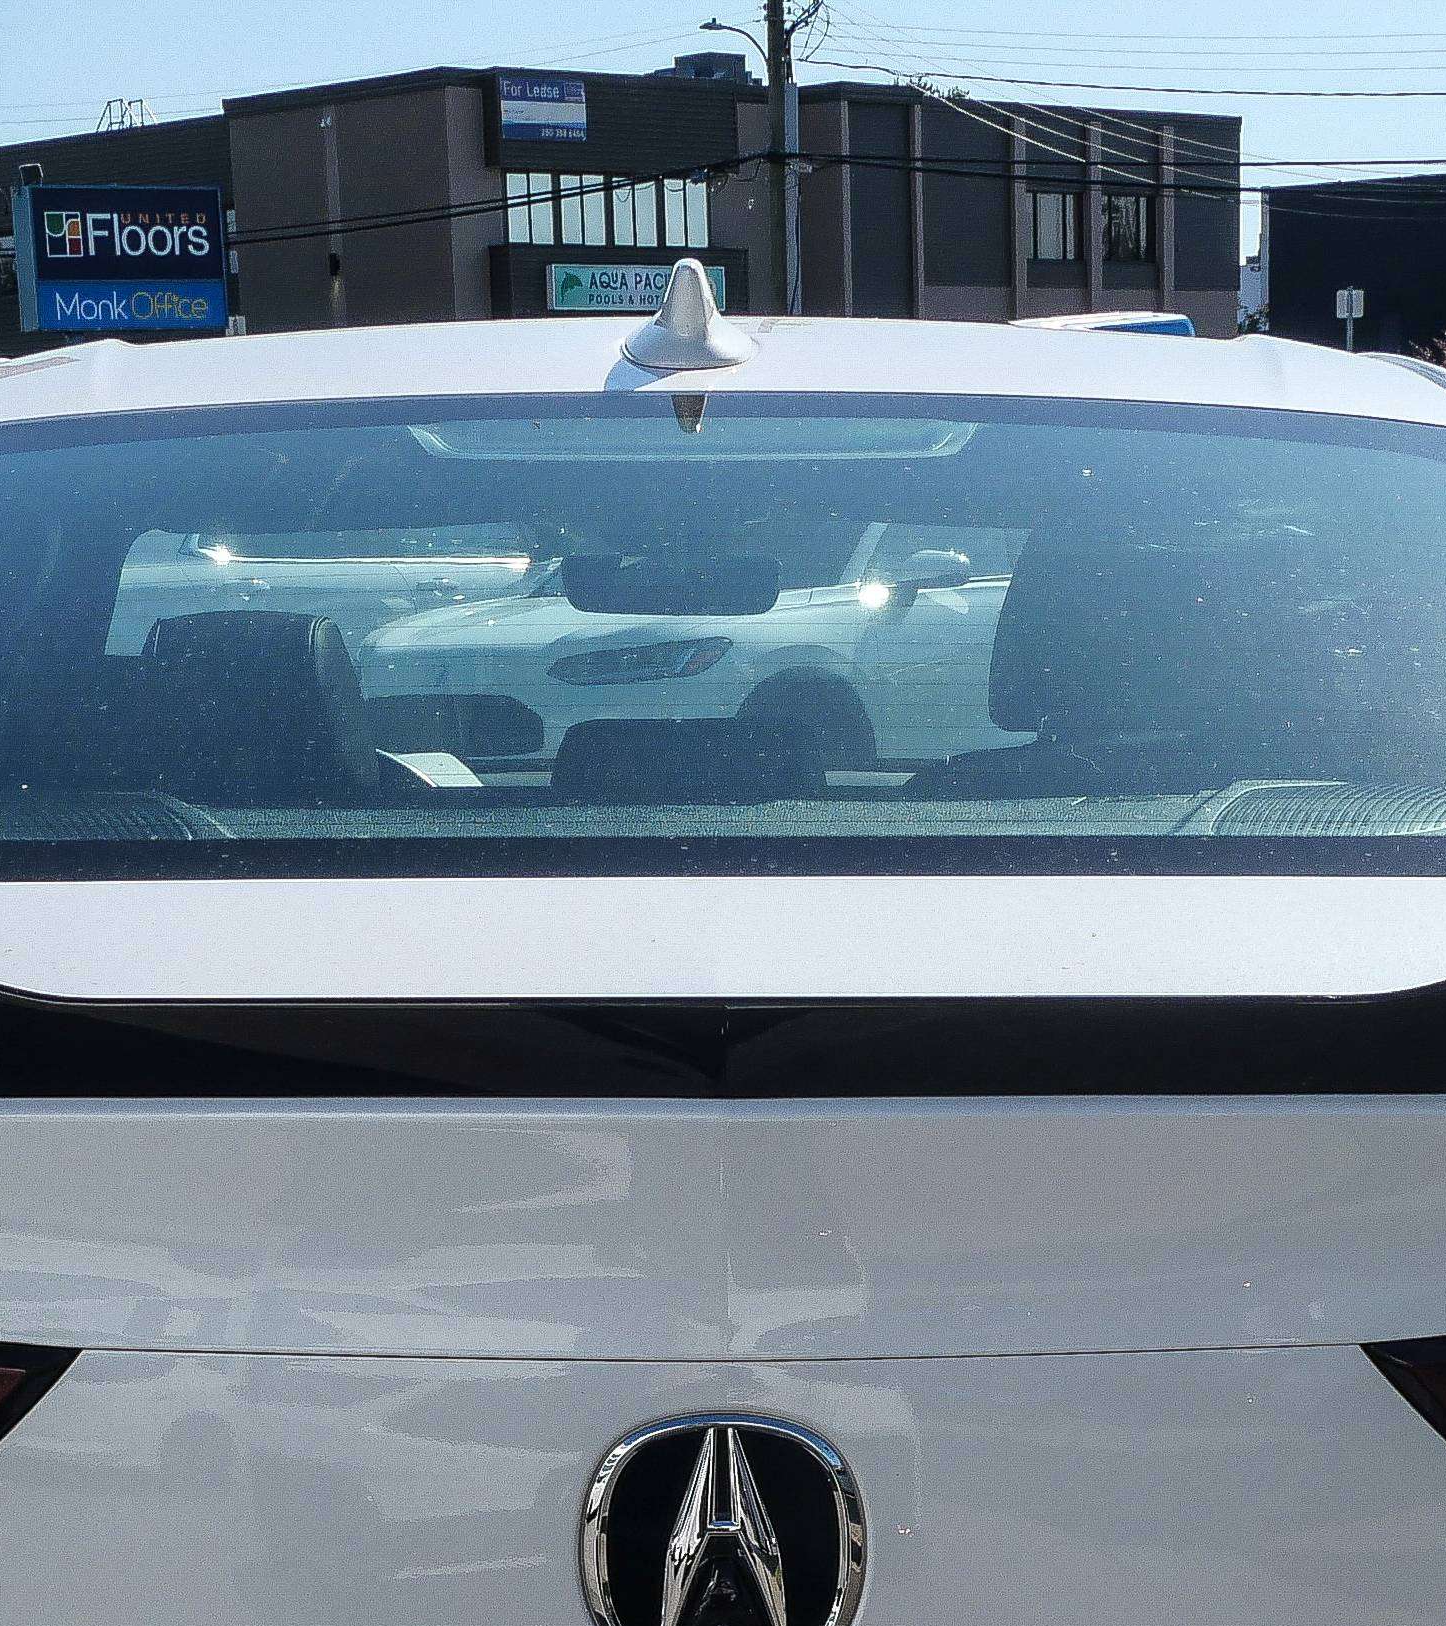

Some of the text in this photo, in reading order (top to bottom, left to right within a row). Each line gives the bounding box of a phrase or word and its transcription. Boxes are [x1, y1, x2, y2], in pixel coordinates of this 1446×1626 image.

[503, 80, 523, 97] For
[526, 81, 560, 98] Lease
[120, 212, 206, 225] UNITED
[86, 213, 210, 256] Floors
[589, 271, 672, 291] AQUA PACI
[55, 290, 208, 321] Monk Office
[588, 293, 623, 305] POOLS
[639, 294, 660, 305] HOT
